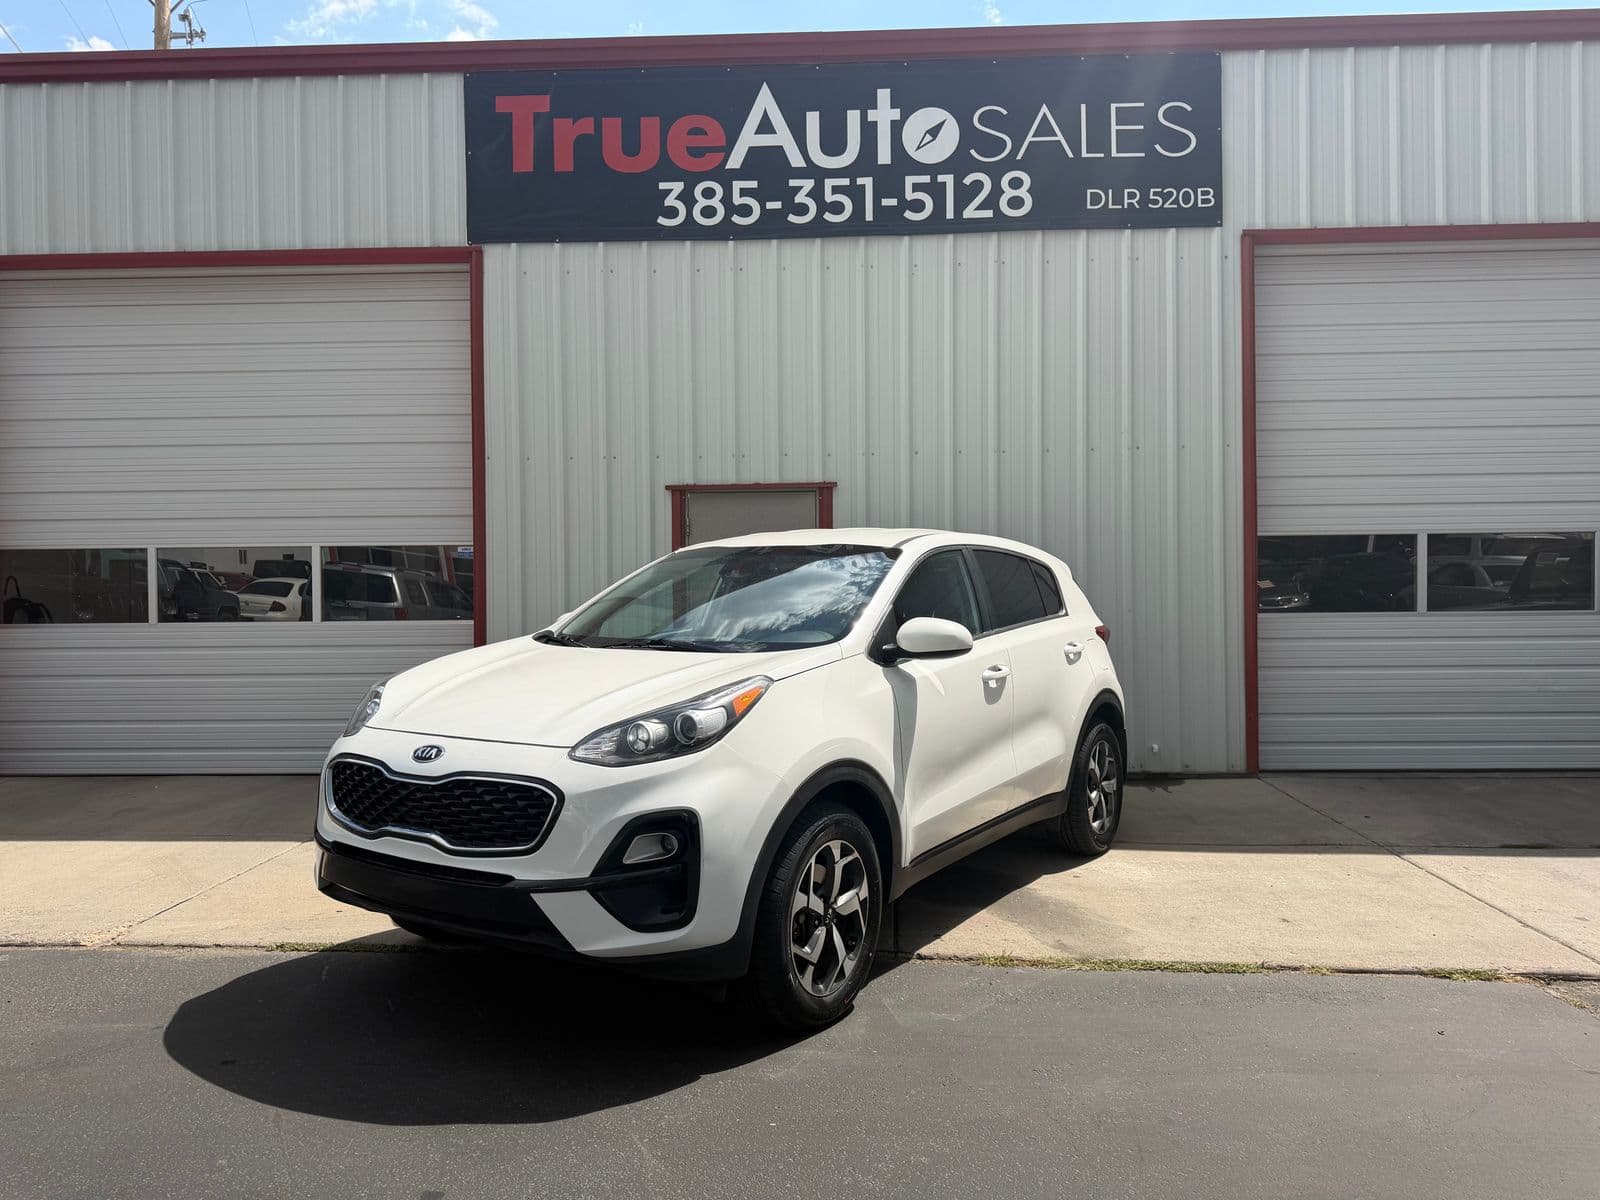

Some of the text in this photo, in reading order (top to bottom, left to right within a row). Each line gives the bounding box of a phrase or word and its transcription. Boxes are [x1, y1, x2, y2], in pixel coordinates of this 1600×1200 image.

[969, 100, 1198, 163] SALES
[656, 170, 1034, 227] 385-351-5128
[1086, 187, 1216, 210] DLR 520B
